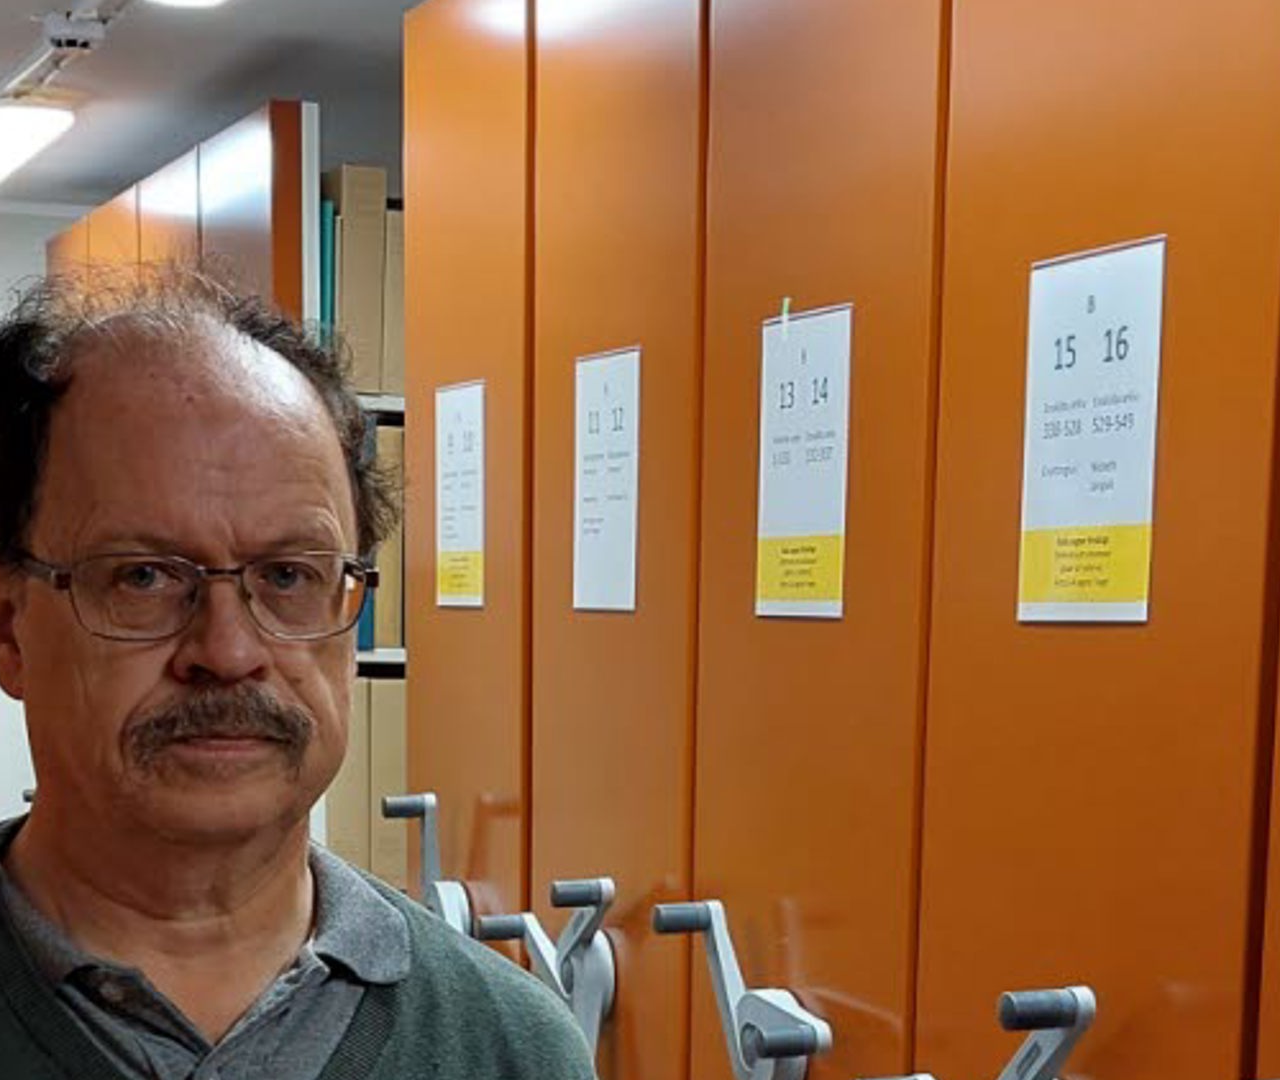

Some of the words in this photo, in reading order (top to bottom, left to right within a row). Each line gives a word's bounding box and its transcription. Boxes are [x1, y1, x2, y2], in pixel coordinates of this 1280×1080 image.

[1054, 335, 1077, 370] 15
[1102, 324, 1130, 363] 16
[780, 381, 794, 409] 13
[811, 376, 828, 405] 14
